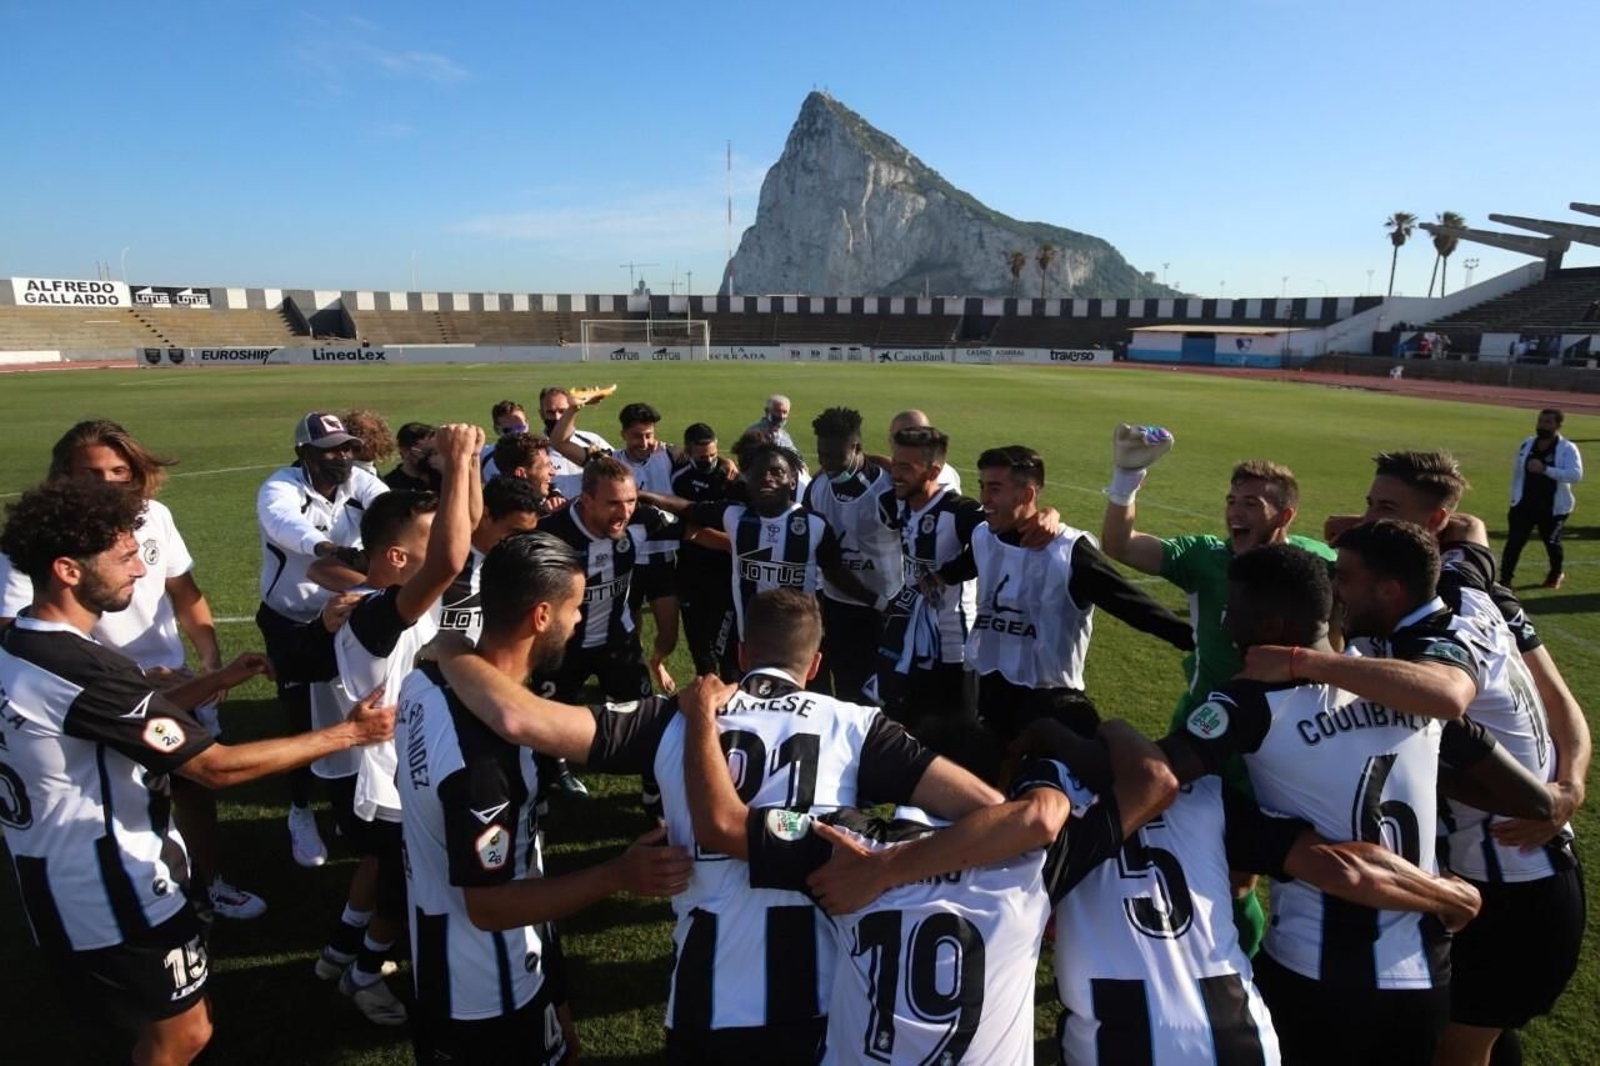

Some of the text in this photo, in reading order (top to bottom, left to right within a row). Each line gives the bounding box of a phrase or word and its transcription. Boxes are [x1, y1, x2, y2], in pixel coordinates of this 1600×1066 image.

[26, 279, 115, 294] ALFREDO
[23, 291, 120, 306] GALLARDO
[136, 293, 170, 304] LOTUS
[176, 293, 208, 305] LOTUS
[312, 348, 386, 362] LineaLex
[610, 351, 640, 361] LOTUS
[651, 351, 681, 361] LOTUS
[894, 350, 945, 362] CaixaBank
[1050, 350, 1095, 362] traverso
[738, 559, 806, 588] LOTUS
[439, 609, 483, 628] LOT
[972, 614, 1037, 640] EGEA
[1115, 815, 1194, 940] 5
[163, 935, 208, 989] 15
[851, 908, 986, 1066] 19
